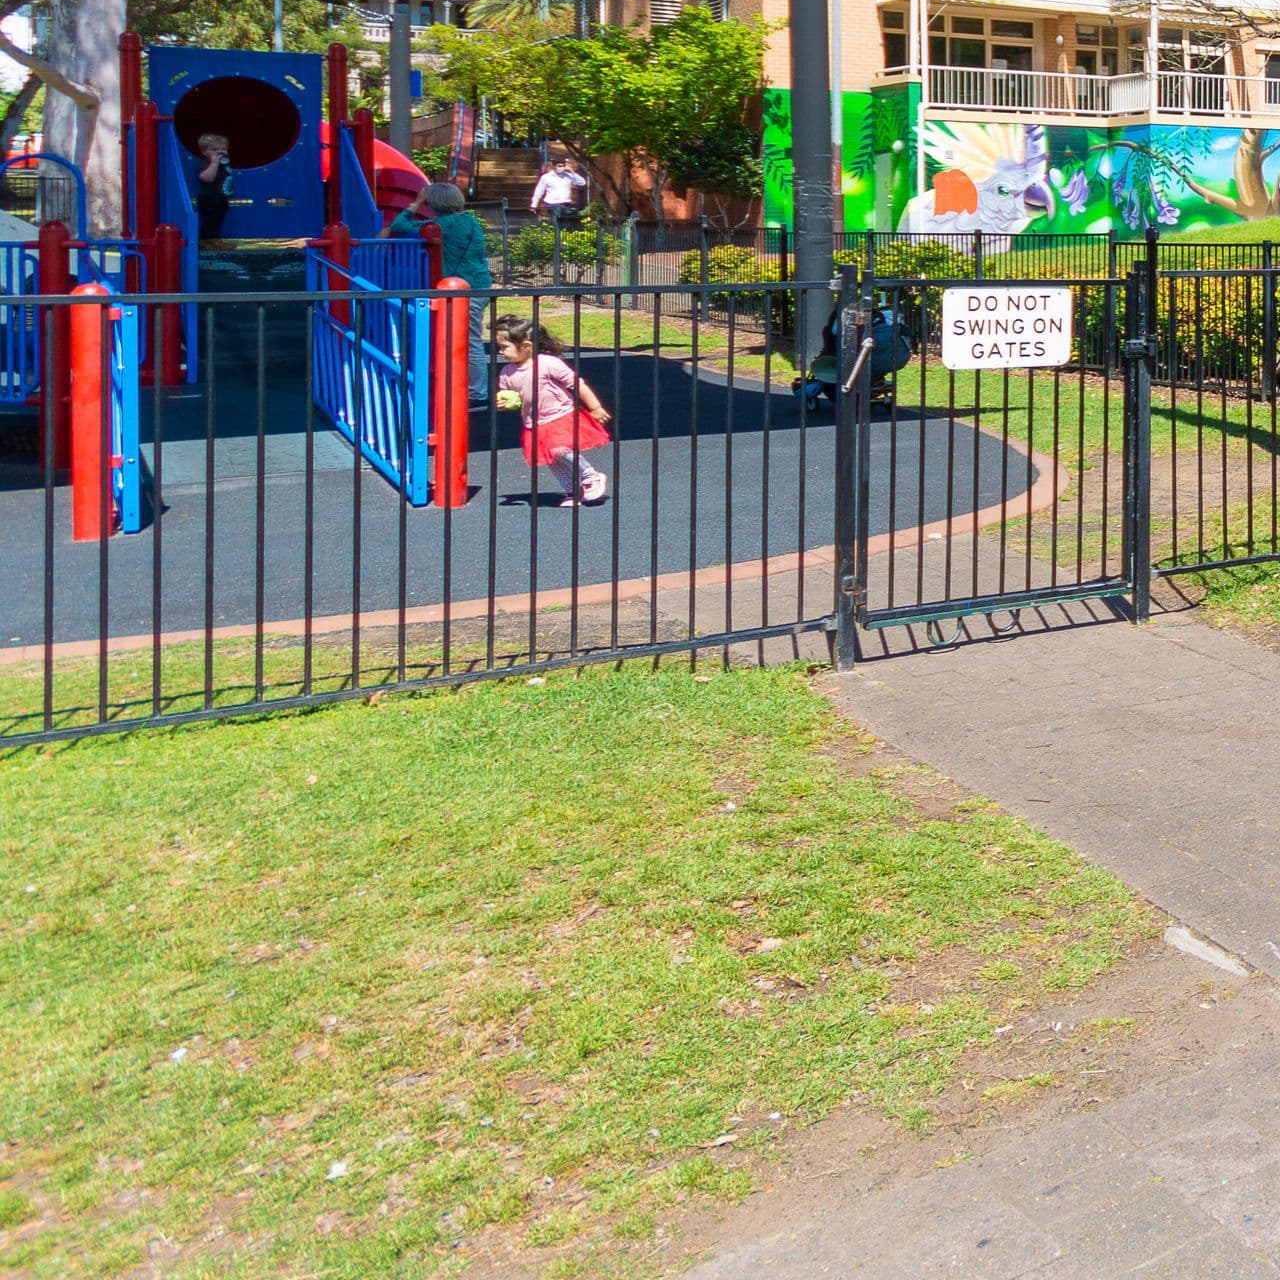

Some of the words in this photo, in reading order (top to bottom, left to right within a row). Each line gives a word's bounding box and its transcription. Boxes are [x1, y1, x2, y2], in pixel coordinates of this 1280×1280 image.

[967, 295, 998, 312] DO
[1007, 295, 1051, 311] NOT
[952, 318, 1025, 336] SWING
[1033, 317, 1063, 334] ON
[971, 341, 1046, 359] GATES
